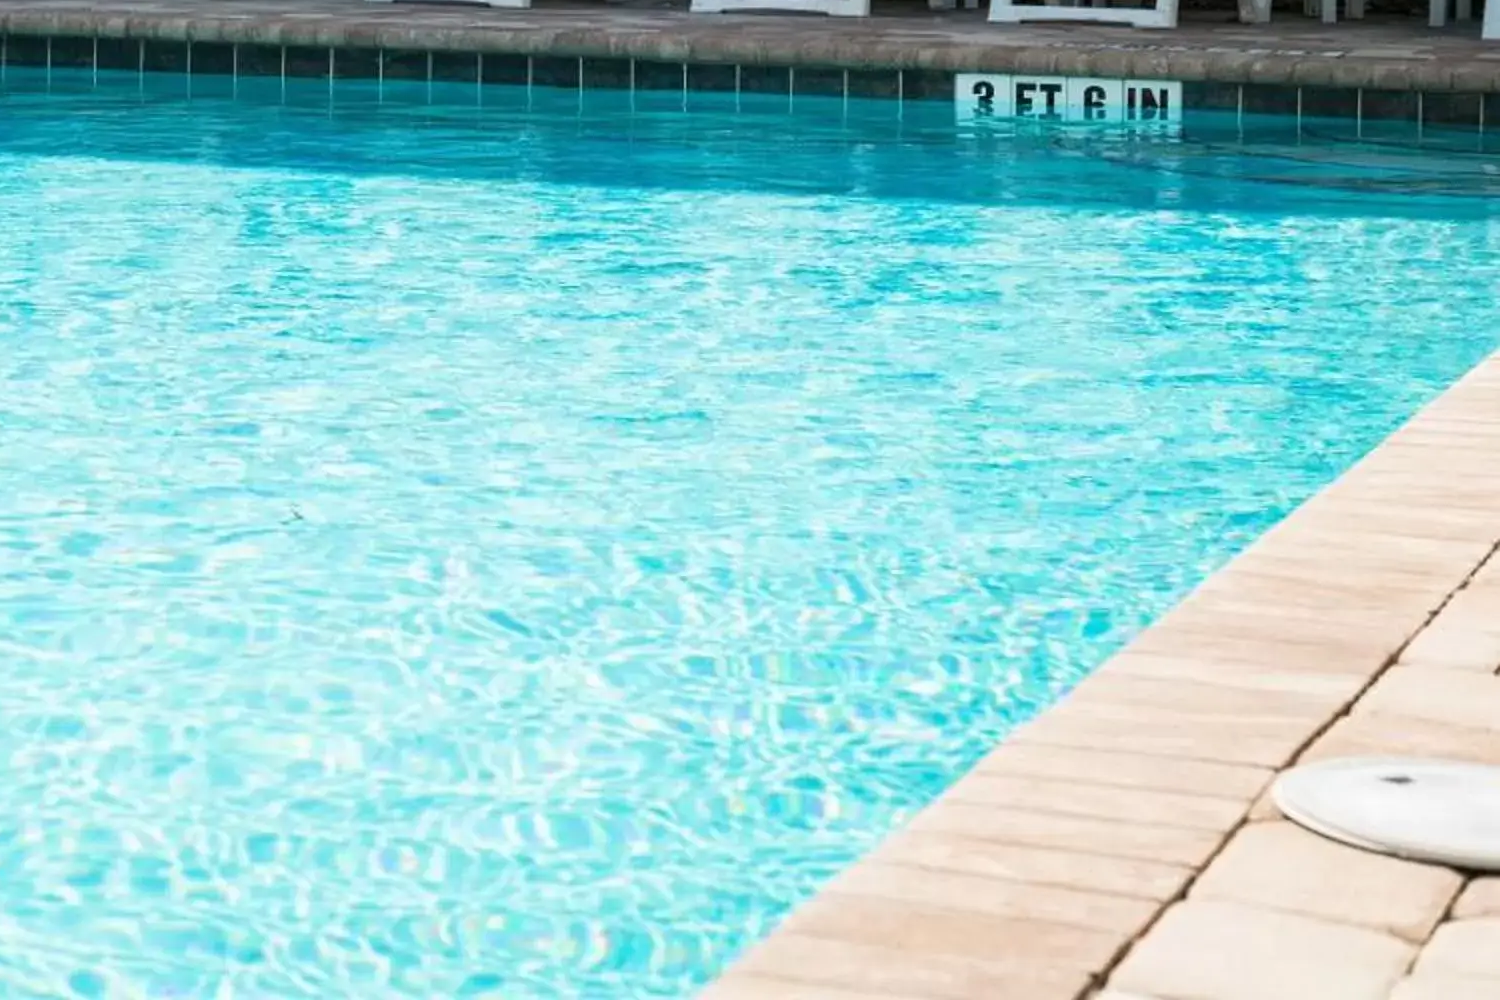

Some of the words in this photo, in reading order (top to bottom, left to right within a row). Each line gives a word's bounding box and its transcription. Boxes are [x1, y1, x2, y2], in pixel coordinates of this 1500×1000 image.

[973, 81, 995, 113] 3
[1016, 83, 1063, 117] FT
[1127, 87, 1169, 119] IN
